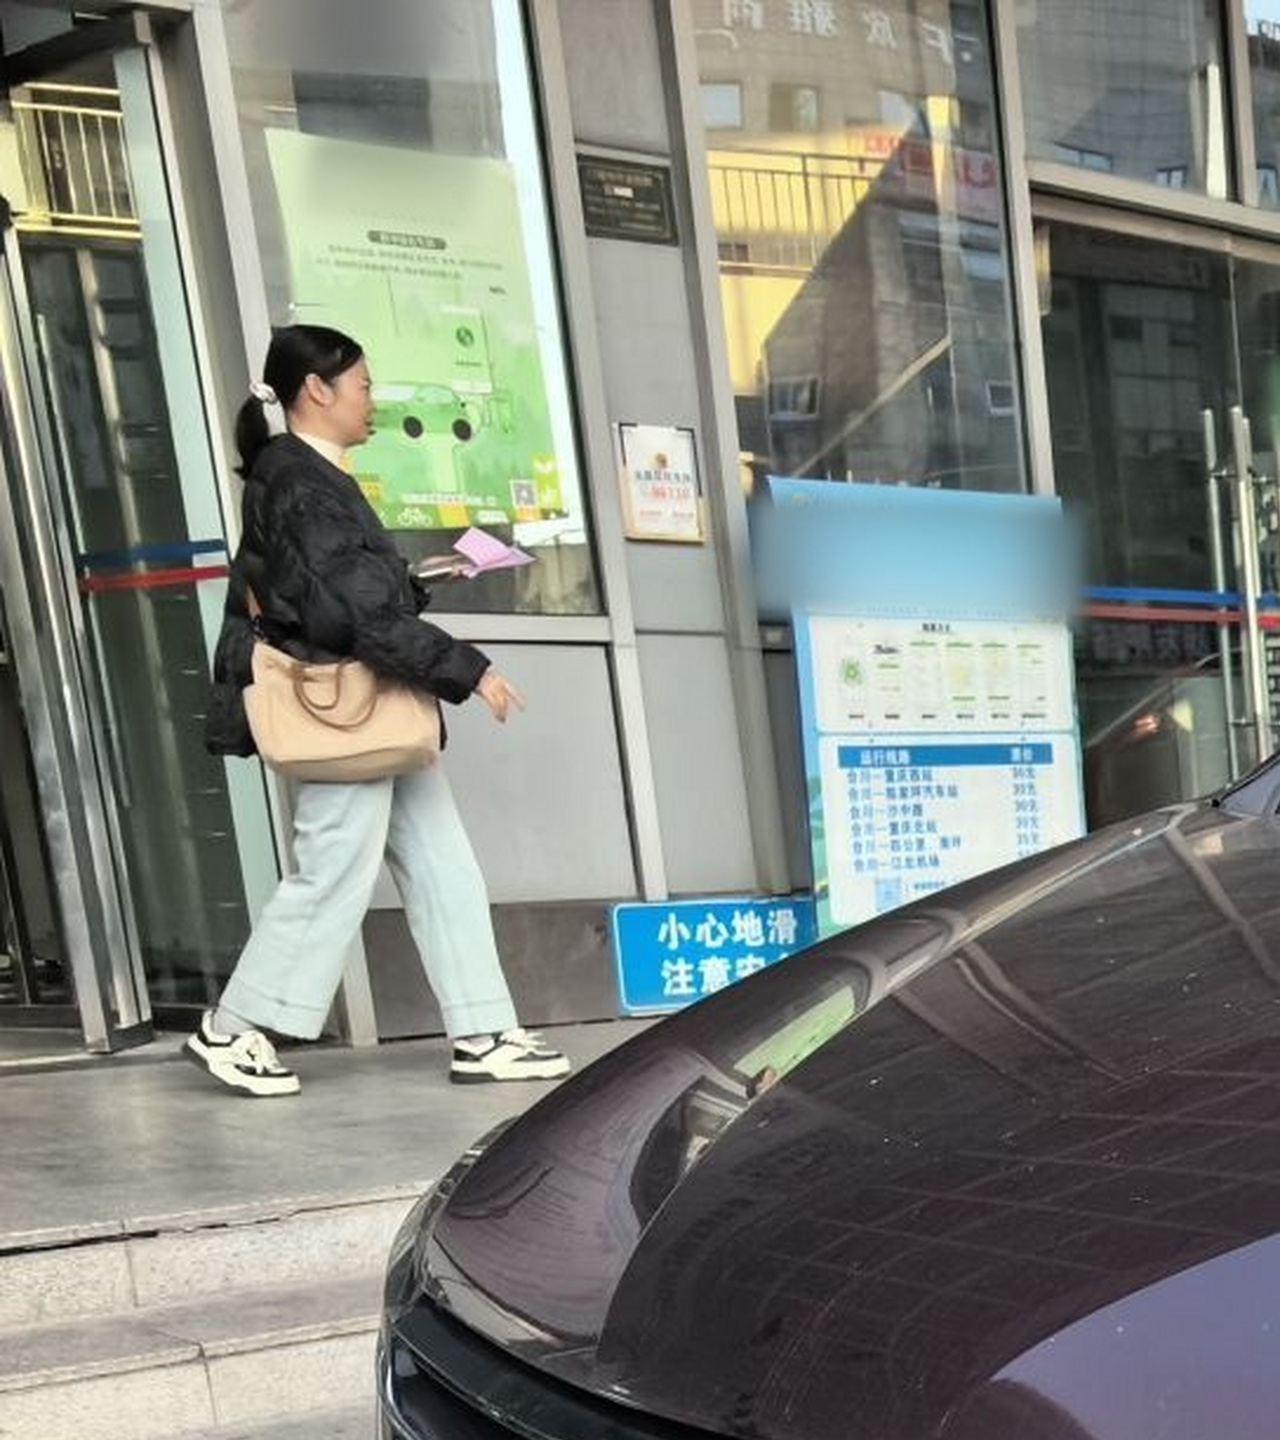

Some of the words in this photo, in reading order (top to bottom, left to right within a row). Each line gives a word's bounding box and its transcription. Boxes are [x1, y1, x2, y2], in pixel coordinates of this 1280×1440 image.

[658, 909, 797, 949] 小心地滑
[660, 954, 789, 996] 注意安
